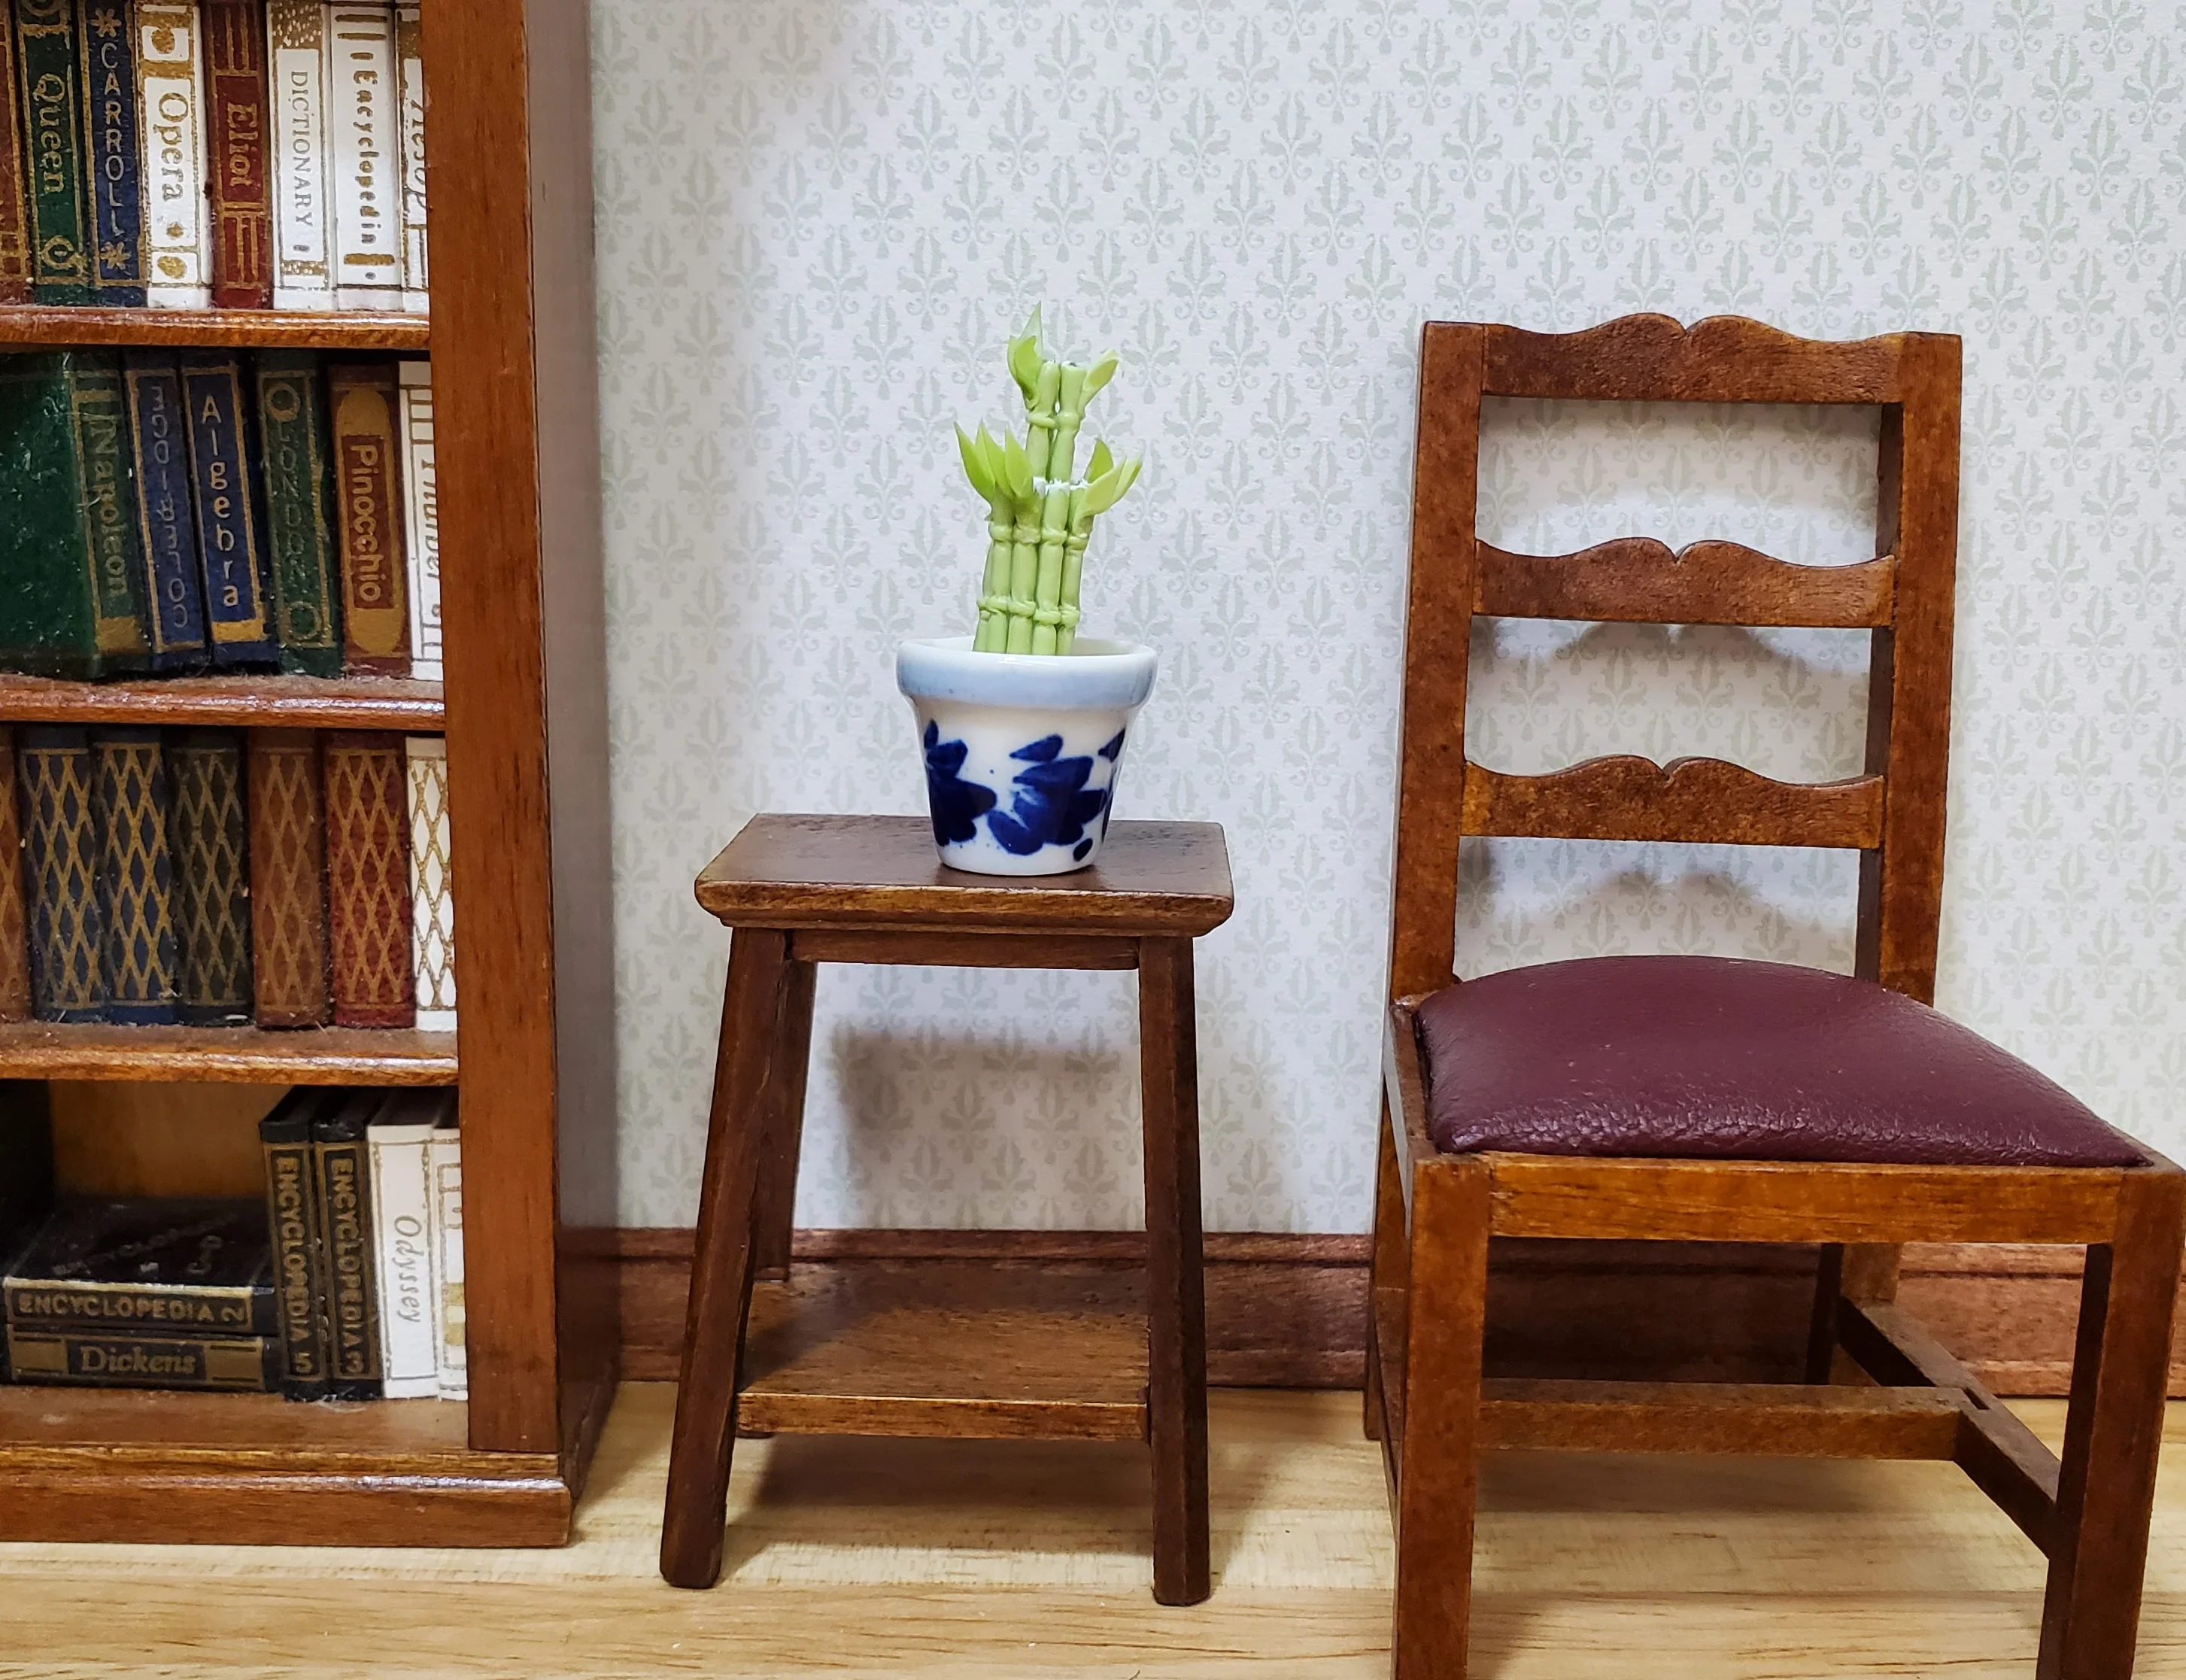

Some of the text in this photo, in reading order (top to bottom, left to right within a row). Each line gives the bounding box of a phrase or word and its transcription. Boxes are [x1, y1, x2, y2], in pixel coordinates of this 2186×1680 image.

[33, 73, 65, 193] Queen
[100, 42, 125, 237] CARROLL
[153, 92, 190, 202] Opera
[227, 102, 260, 187] Eliot
[291, 71, 313, 226] DICTIONARY
[90, 424, 129, 597] Napoleon
[202, 395, 238, 607] Algebra
[349, 443, 387, 602] Pinocchio
[19, 1293, 246, 1322] ENCYCLOPEDIA 2
[276, 1156, 313, 1374] ENCYCLOPEDIA 5
[331, 1158, 365, 1373] ENCYCLOPEDIA 3
[391, 1214, 425, 1323] Odyssey
[80, 1345, 196, 1372] Dickens
